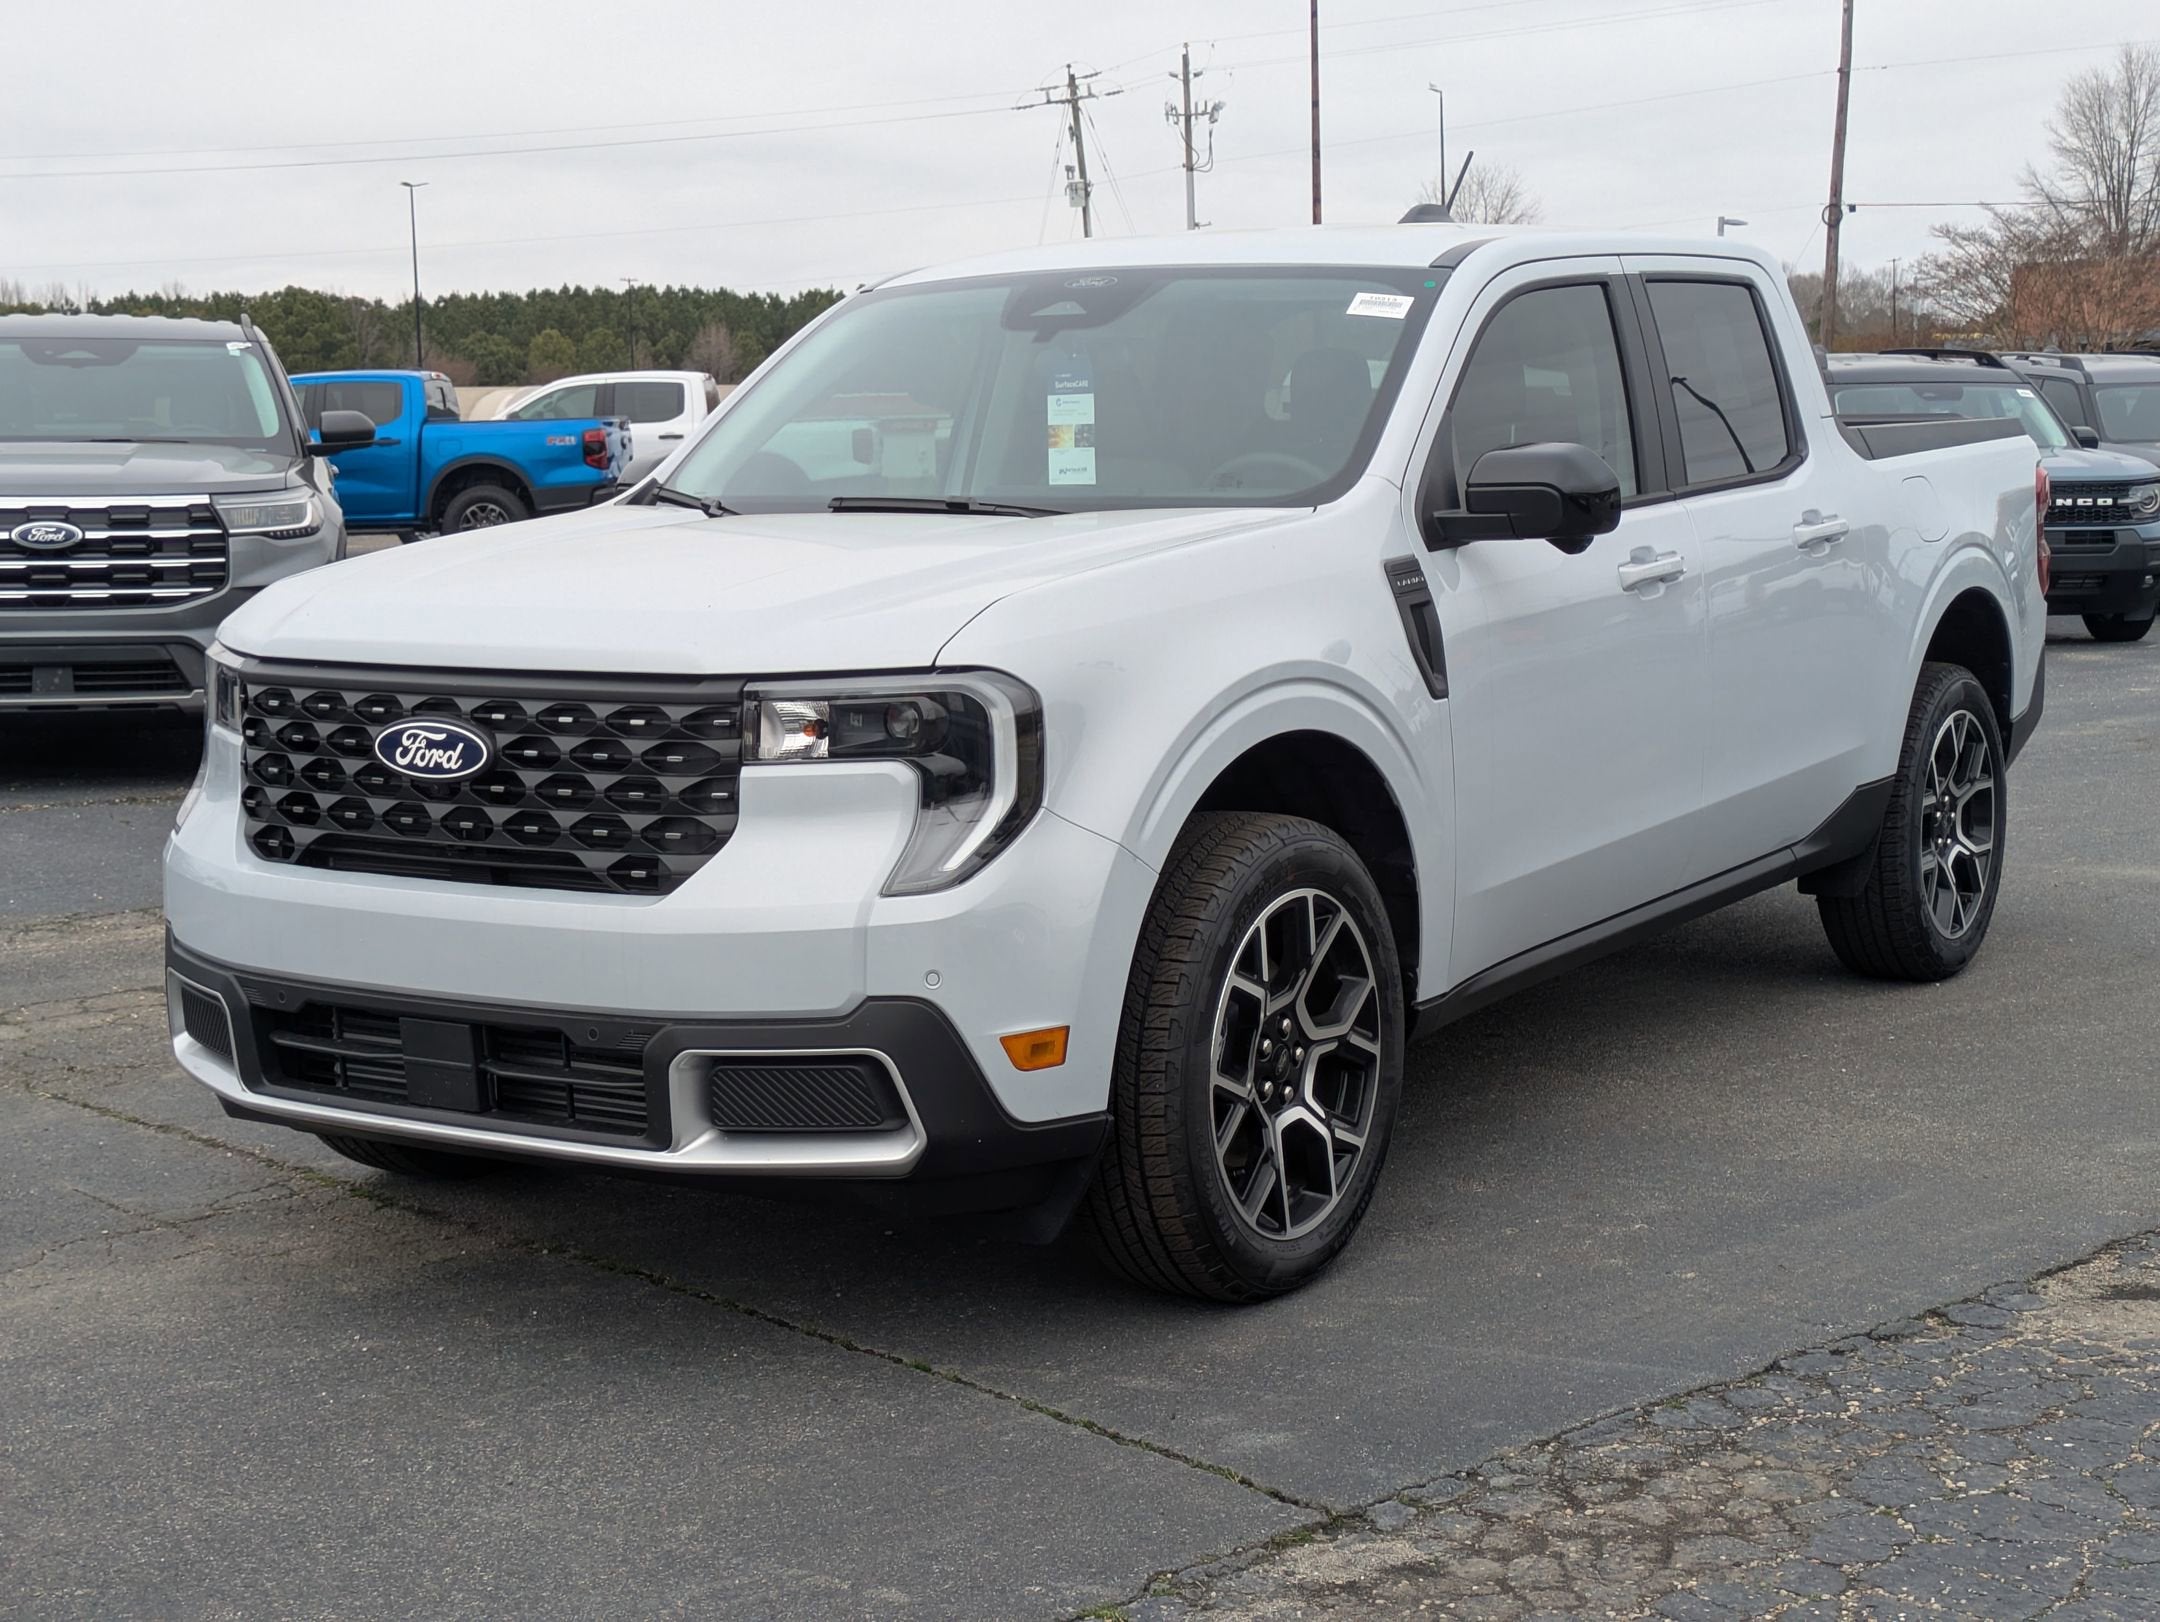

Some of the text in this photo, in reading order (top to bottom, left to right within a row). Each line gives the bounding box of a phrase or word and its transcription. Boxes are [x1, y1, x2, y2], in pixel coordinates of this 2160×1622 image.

[2055, 498, 2113, 506] NCO
[27, 527, 66, 542] Ford
[395, 729, 465, 770] Ford
